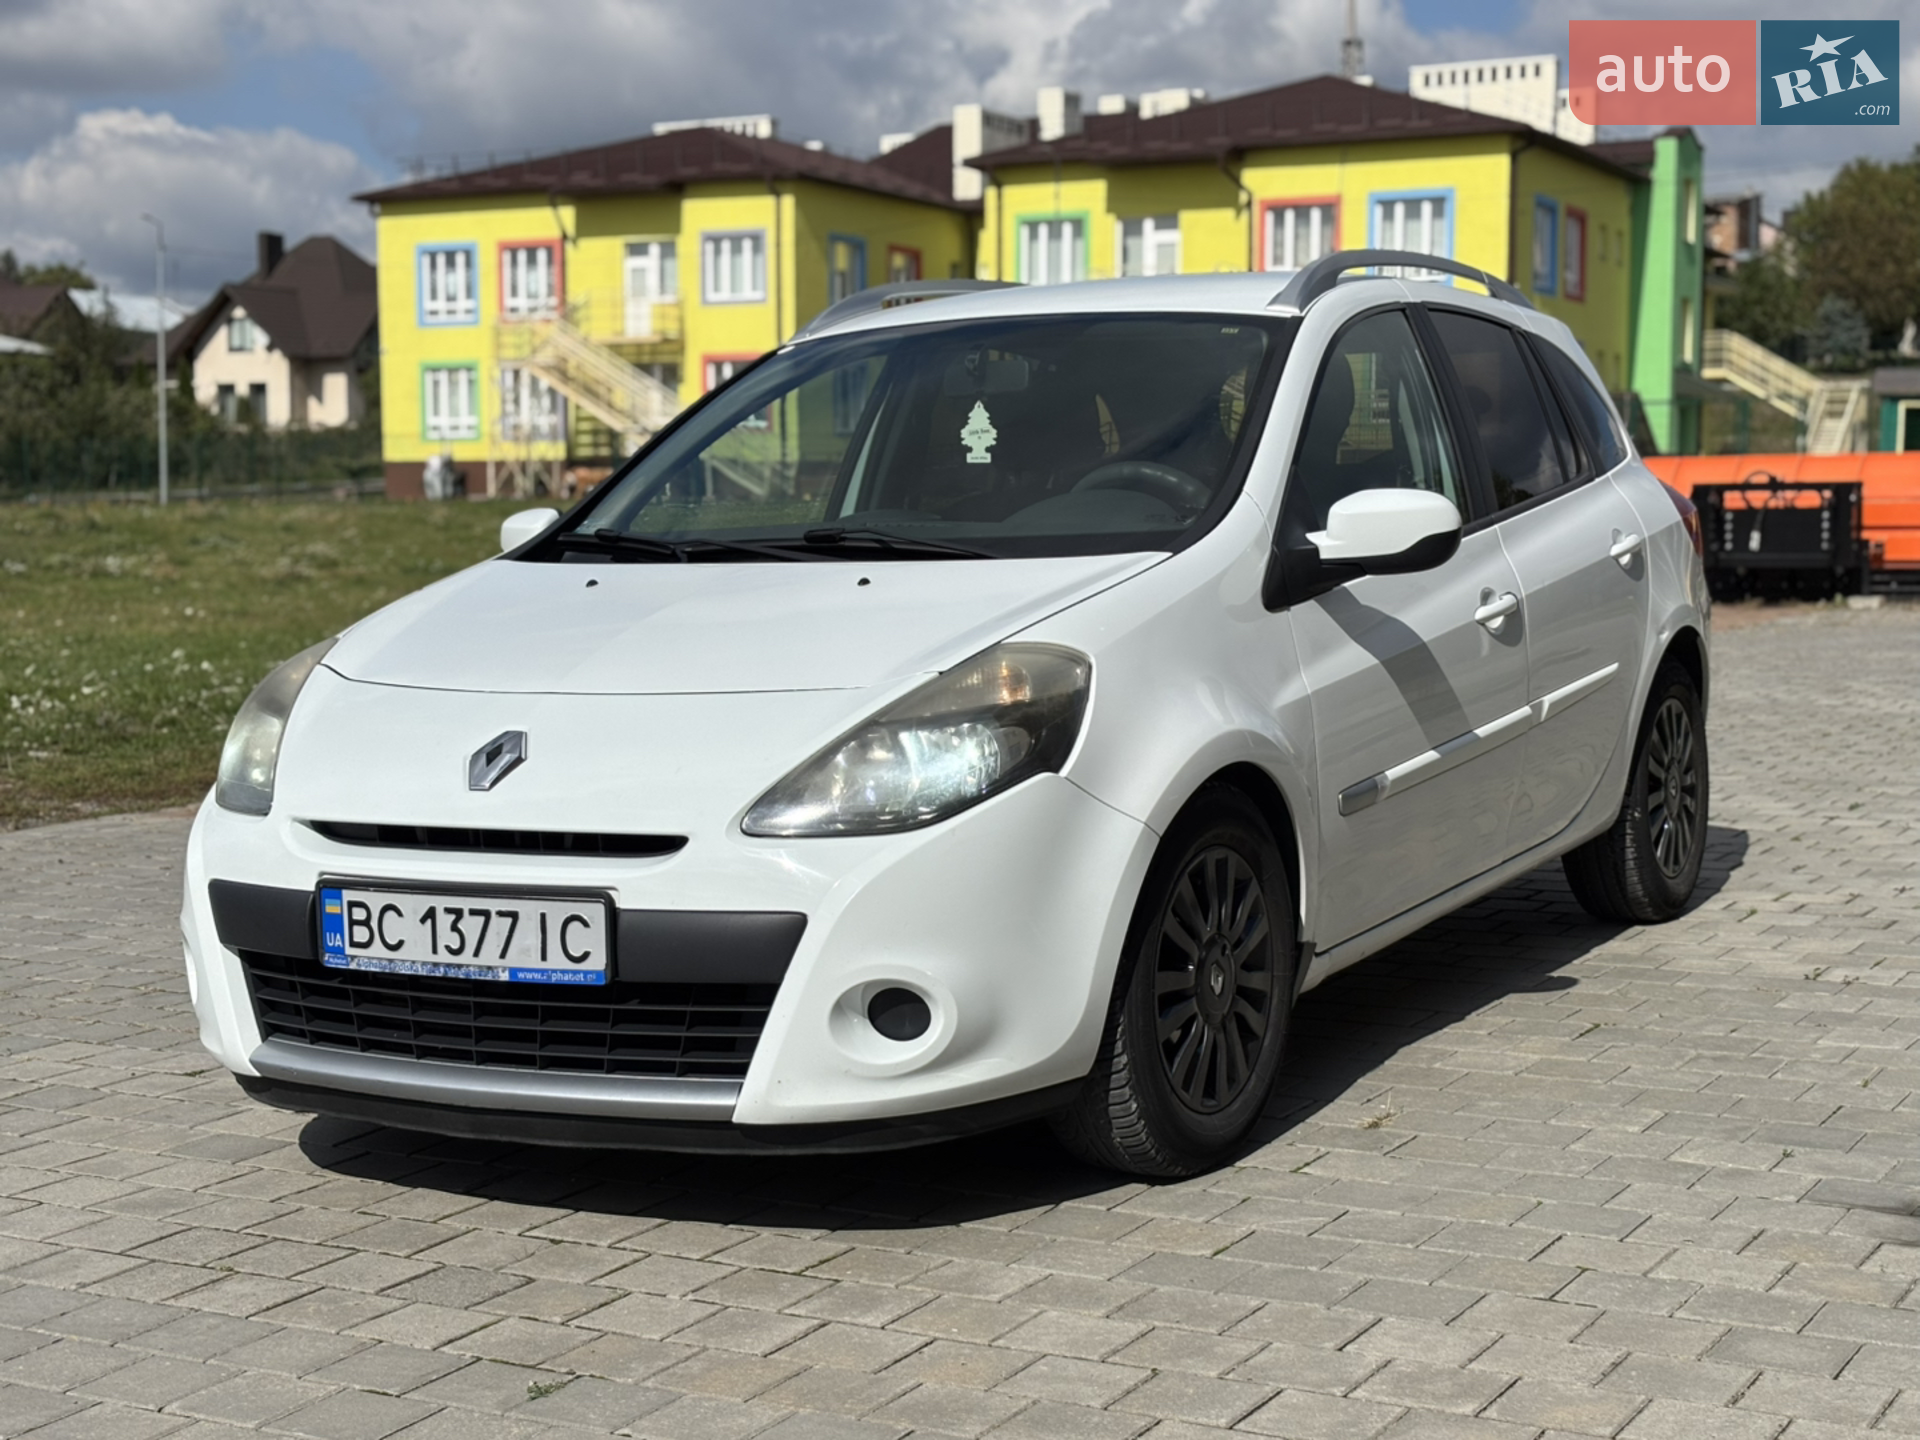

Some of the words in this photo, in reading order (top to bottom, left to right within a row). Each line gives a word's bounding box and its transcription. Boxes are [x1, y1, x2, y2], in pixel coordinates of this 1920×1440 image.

[325, 931, 343, 948] UA
[346, 899, 406, 951] BC
[418, 905, 520, 960] 1377
[539, 911, 592, 964] IC
[516, 970, 597, 983] www.alphabetpl
